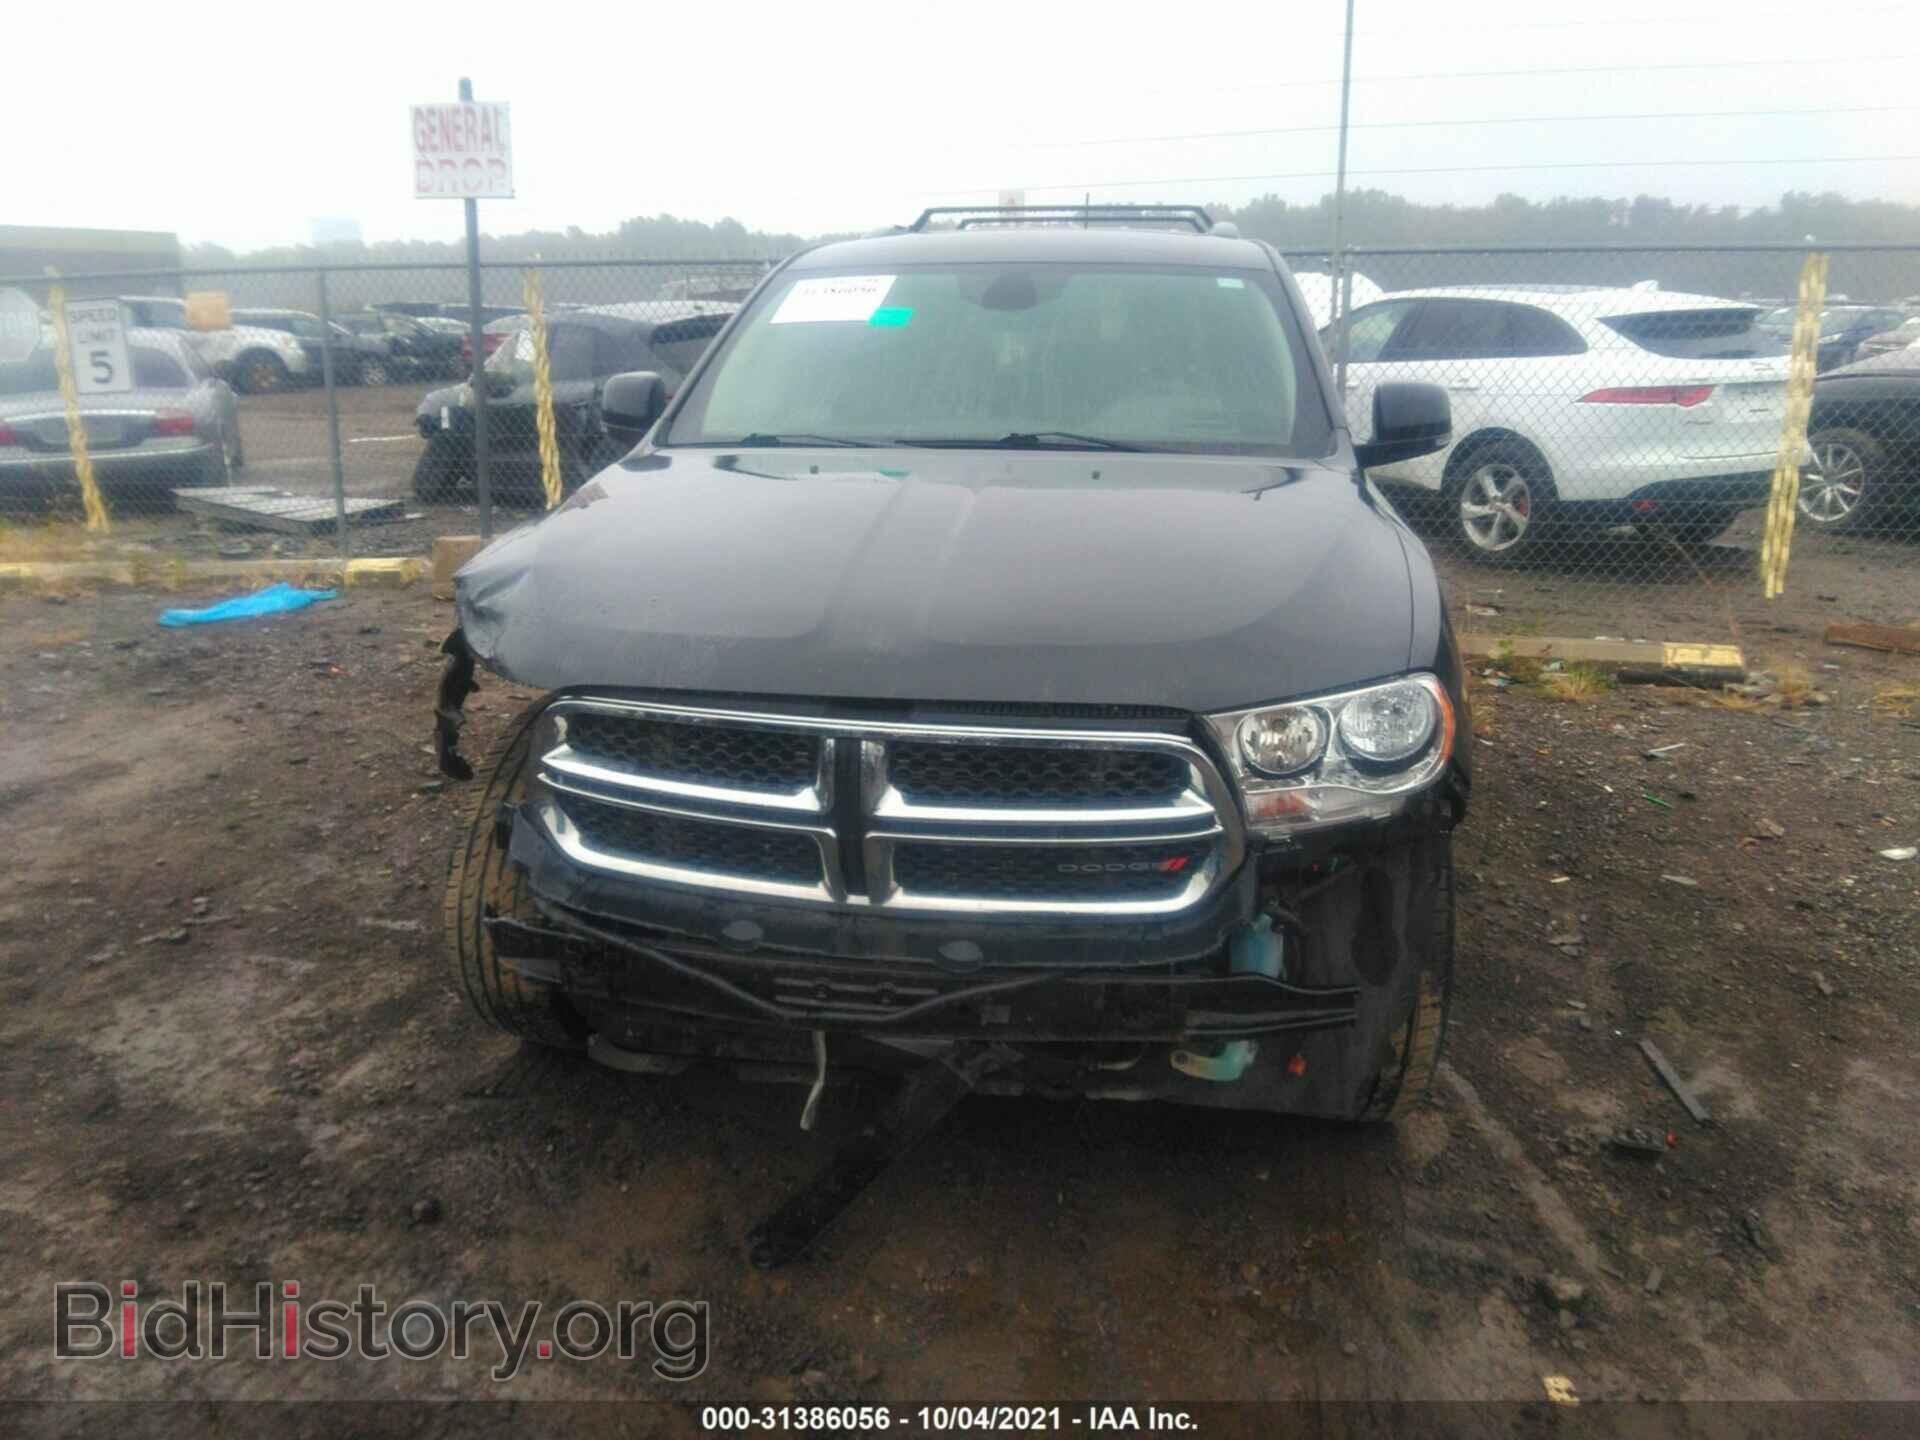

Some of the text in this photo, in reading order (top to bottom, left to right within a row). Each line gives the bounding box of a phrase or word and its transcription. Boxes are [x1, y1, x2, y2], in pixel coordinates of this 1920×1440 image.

[414, 105, 506, 153] GENERAL
[415, 158, 507, 193] DROP
[71, 307, 117, 322] SPEED
[79, 327, 117, 344] LIMIT
[90, 350, 114, 384] 5
